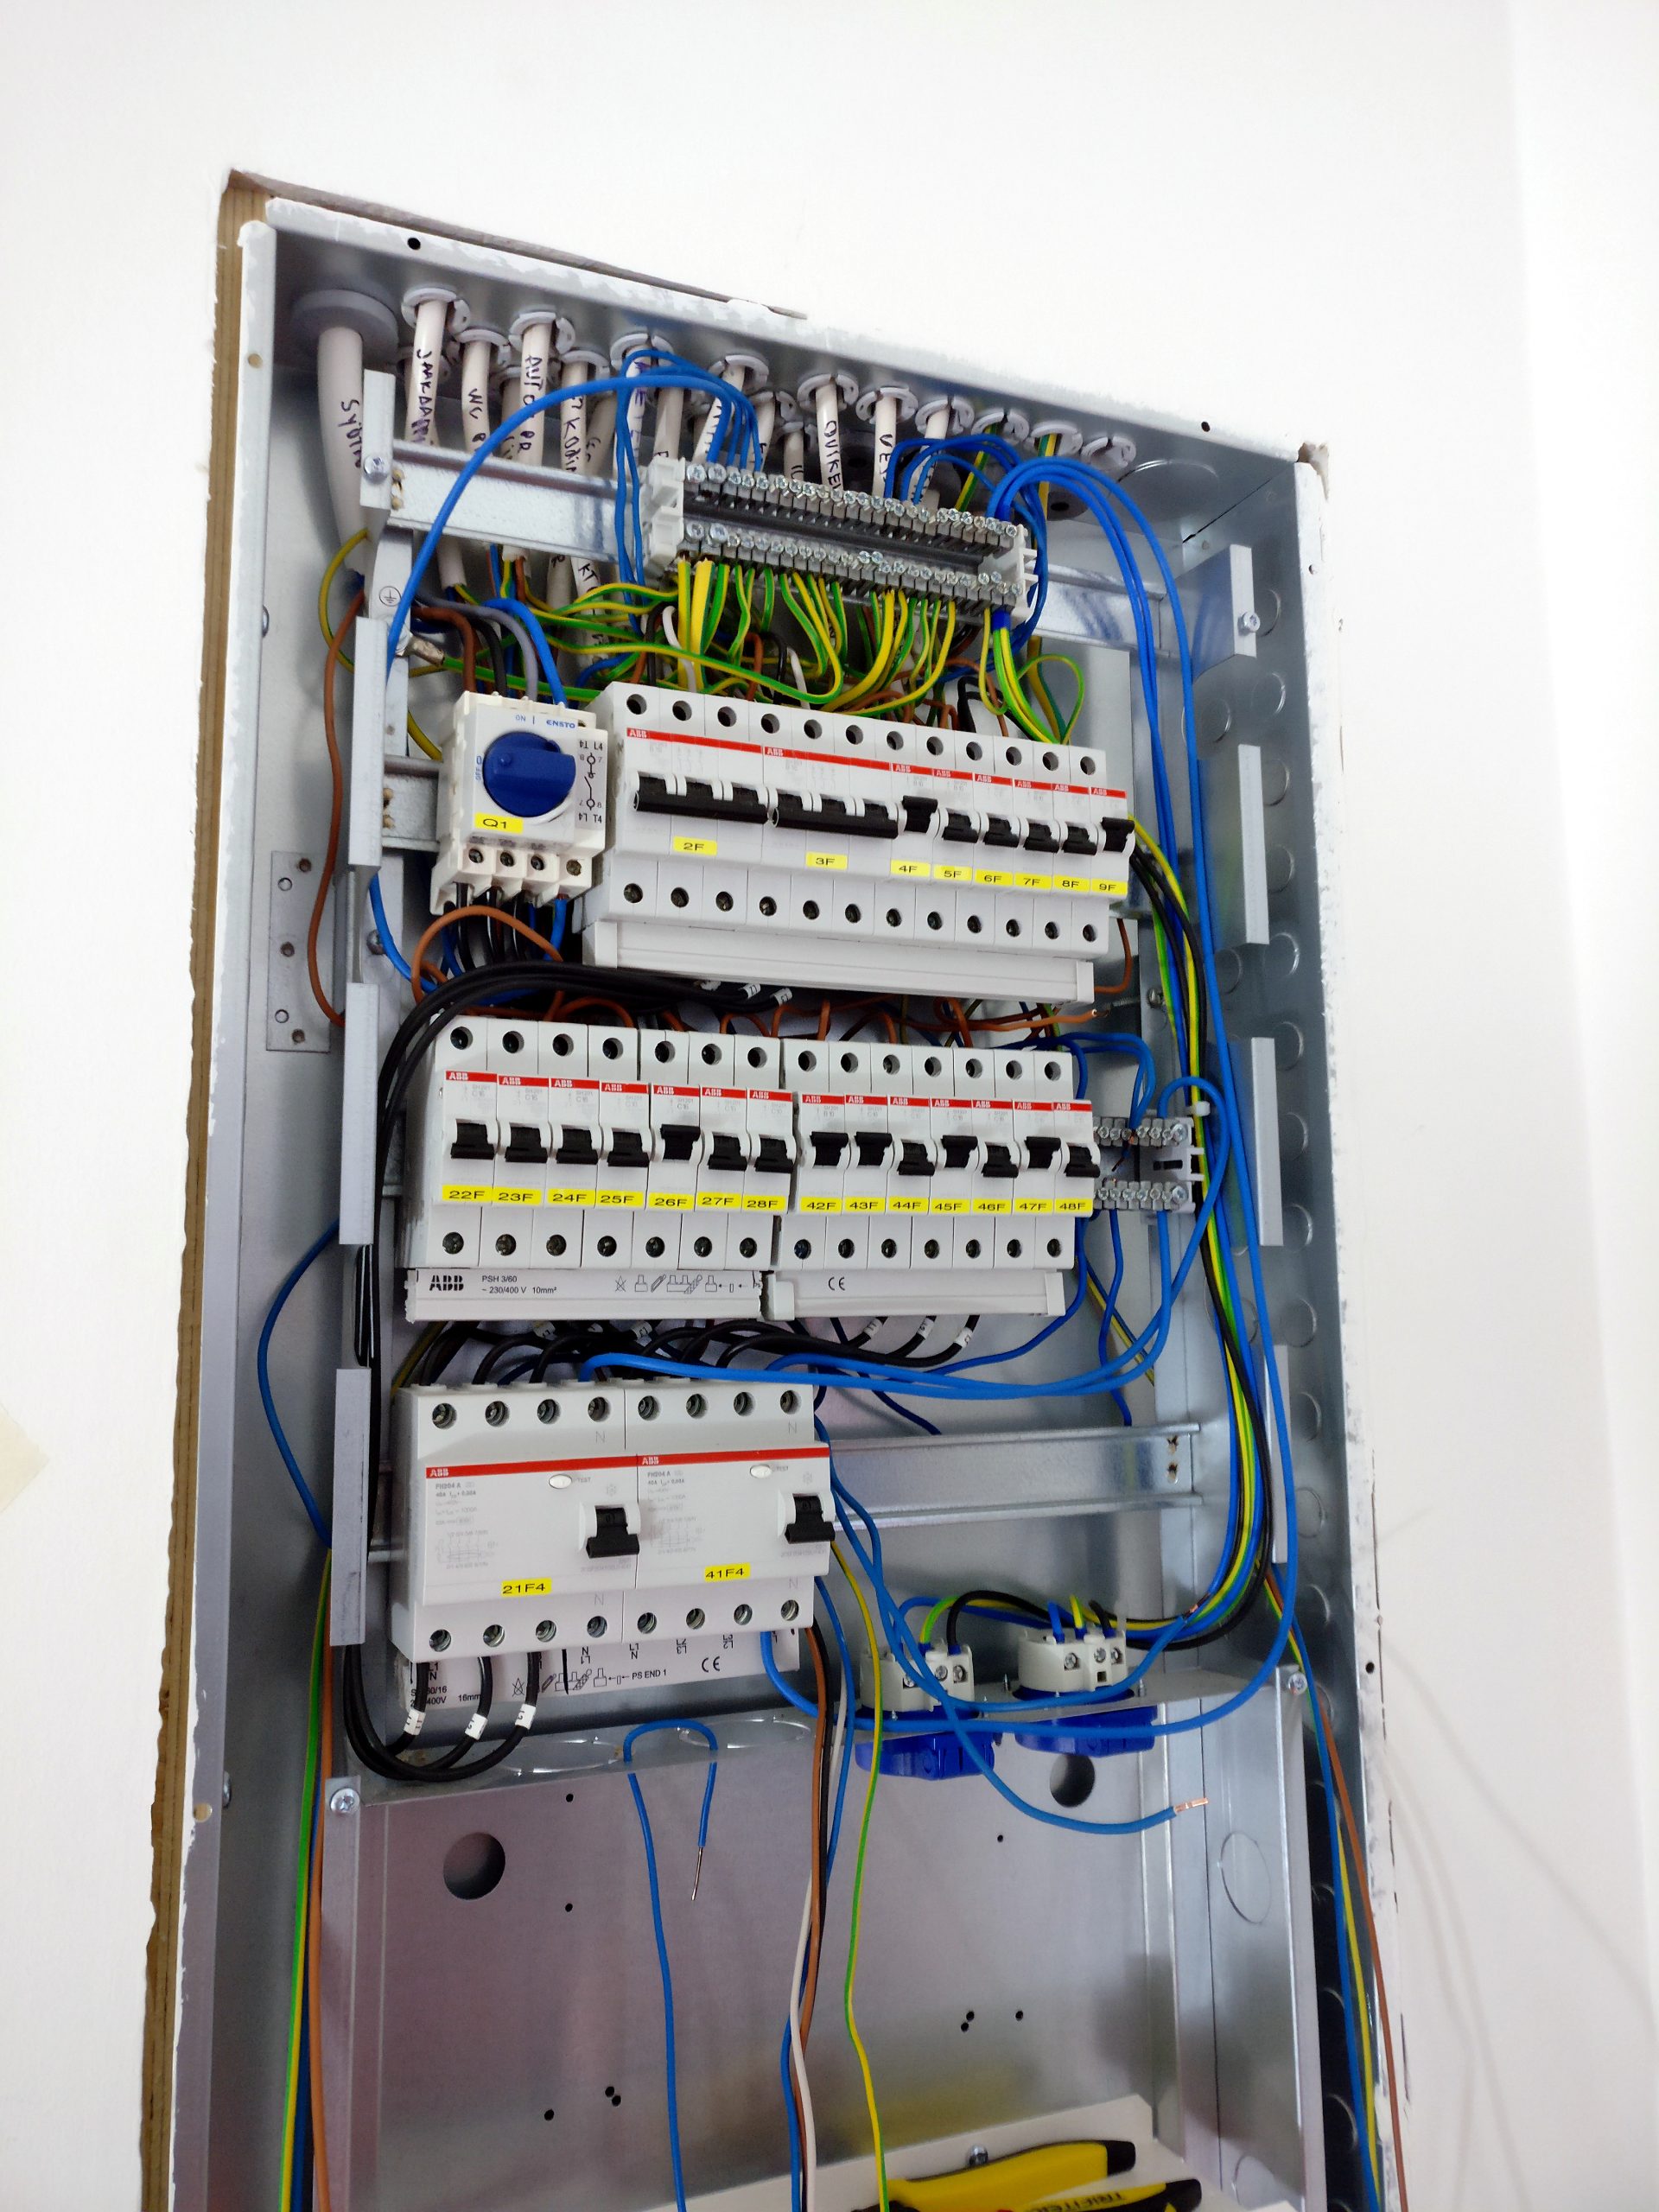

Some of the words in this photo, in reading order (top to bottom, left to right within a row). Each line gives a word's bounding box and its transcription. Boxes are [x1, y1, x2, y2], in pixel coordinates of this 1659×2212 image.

[546, 719, 575, 729] ENSTO
[629, 728, 647, 739] ABB
[766, 747, 784, 757] ABB
[895, 764, 912, 773] ABB
[936, 769, 951, 778] ABB
[976, 774, 992, 783] ABB
[1054, 784, 1069, 792] ABB
[482, 818, 508, 829] Q1
[683, 842, 705, 851] 2F
[815, 857, 836, 866] 3F
[899, 865, 918, 874] 4F
[984, 874, 1002, 883] 6F
[1023, 878, 1041, 887] 7F
[1062, 880, 1080, 888] 8F
[448, 1071, 468, 1080] ABB
[502, 1077, 522, 1085] ABB
[554, 1079, 573, 1088] ABB
[605, 1084, 623, 1092] ABB
[656, 1085, 675, 1095] ABB
[704, 1088, 722, 1096] ABB
[752, 1091, 770, 1100] ABB
[804, 1095, 822, 1103] ABB
[893, 1097, 908, 1106] ABB
[976, 1100, 991, 1109] ABB
[448, 1190, 486, 1199] 22F
[498, 1192, 534, 1202] 23F
[552, 1193, 588, 1202] 24F
[600, 1195, 635, 1204] 25F
[654, 1198, 688, 1207] 26F
[702, 1197, 734, 1206] 27F
[747, 1200, 779, 1209] 28F
[429, 1274, 464, 1292] ABB
[481, 1274, 499, 1283] PSH
[489, 1286, 519, 1294] 230/400
[642, 1456, 659, 1465] ABB
[429, 1468, 449, 1478] ABB
[705, 1568, 745, 1580] 41F4
[502, 1583, 546, 1594] 21F4
[632, 1672, 643, 1681] PS
[645, 1669, 661, 1679] END
